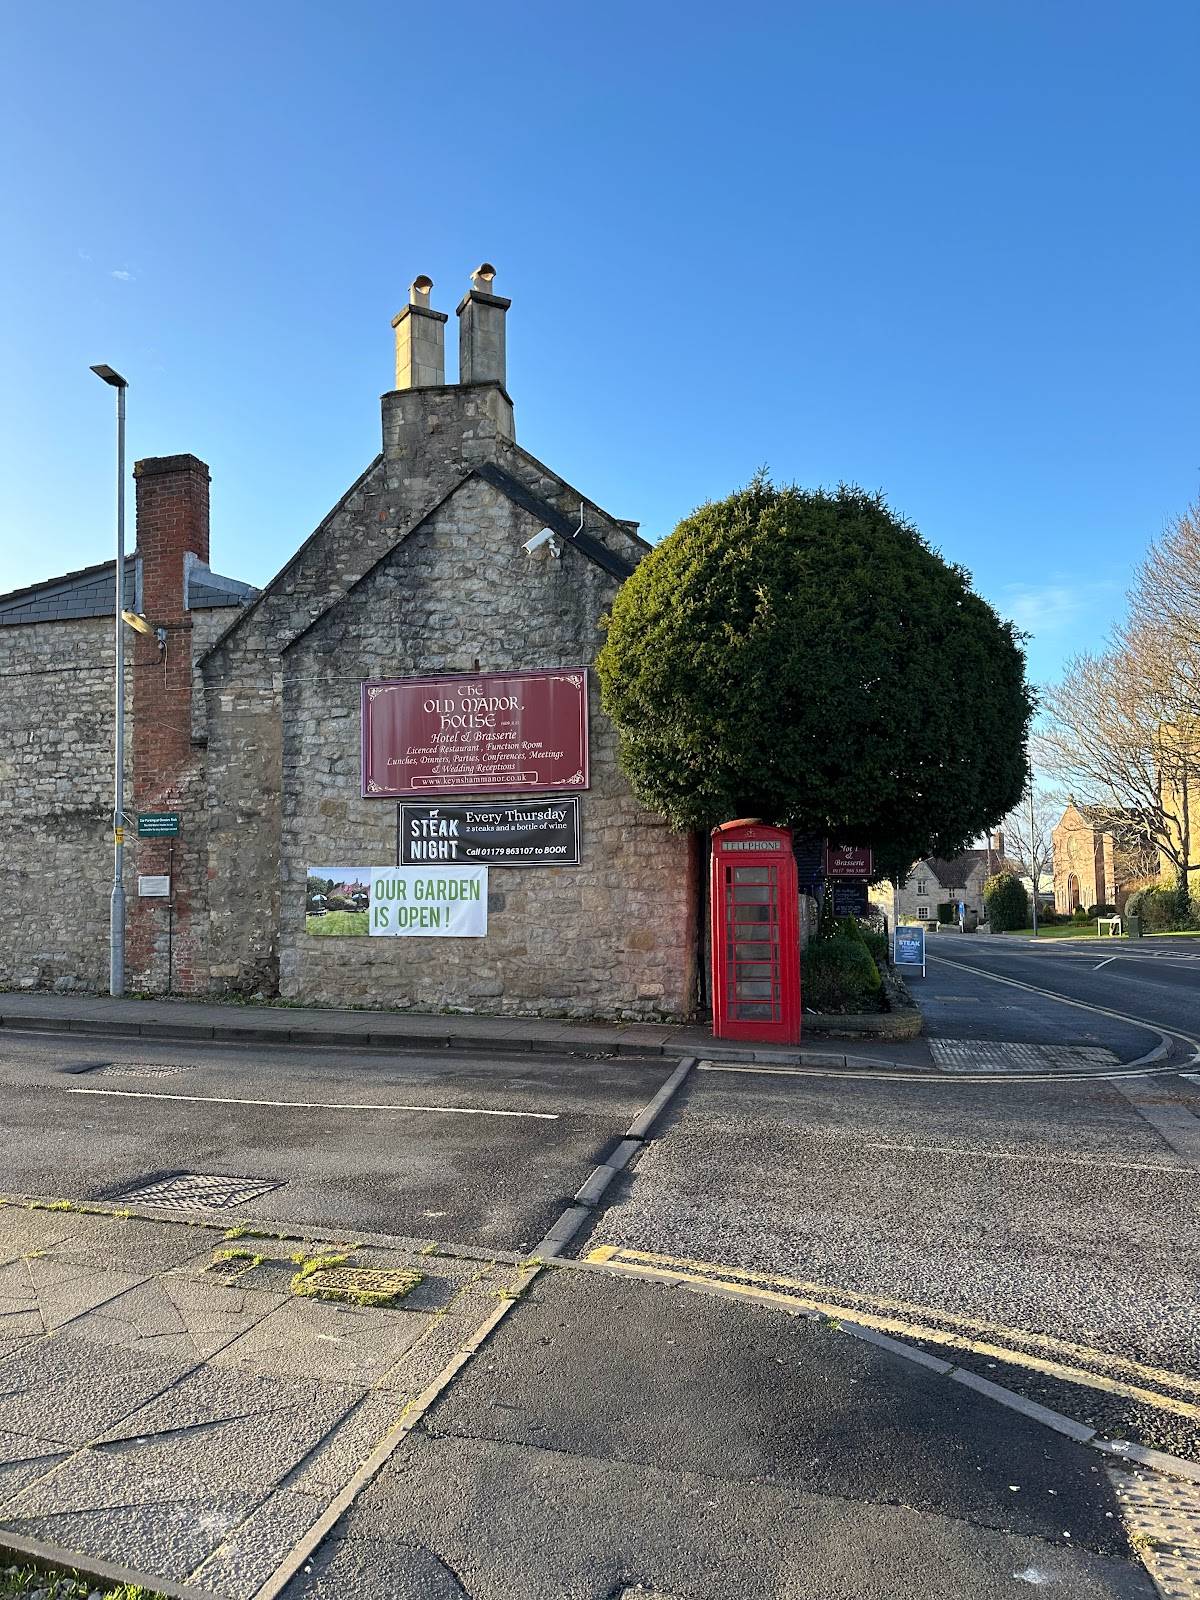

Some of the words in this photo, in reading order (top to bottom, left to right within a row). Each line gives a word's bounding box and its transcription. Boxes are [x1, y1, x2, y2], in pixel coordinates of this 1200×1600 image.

[424, 700, 454, 712] OLD
[431, 731, 458, 744] Hotel
[461, 732, 471, 741] &
[474, 730, 516, 741] Brasserie
[407, 745, 437, 754] Licenced
[486, 742, 519, 751] Function
[387, 757, 417, 766] Lunches,
[420, 755, 450, 764] Dinners,
[453, 754, 479, 763] Parties,
[482, 752, 526, 762] Conferences,
[529, 750, 564, 761] Meetings
[441, 765, 474, 775] Wedding
[476, 763, 515, 773] Receptions
[422, 775, 527, 786] www.keynshammanor.co.uk
[466, 811, 502, 824] Every
[505, 808, 567, 822] Thursday
[410, 819, 459, 837] STEAK
[410, 840, 458, 859] NIGHT
[724, 841, 780, 850] TELEPHONE
[375, 880, 407, 900] OUR
[414, 879, 480, 900] GARDEN
[374, 907, 389, 928] IS
[398, 907, 450, 927] OPEN!
